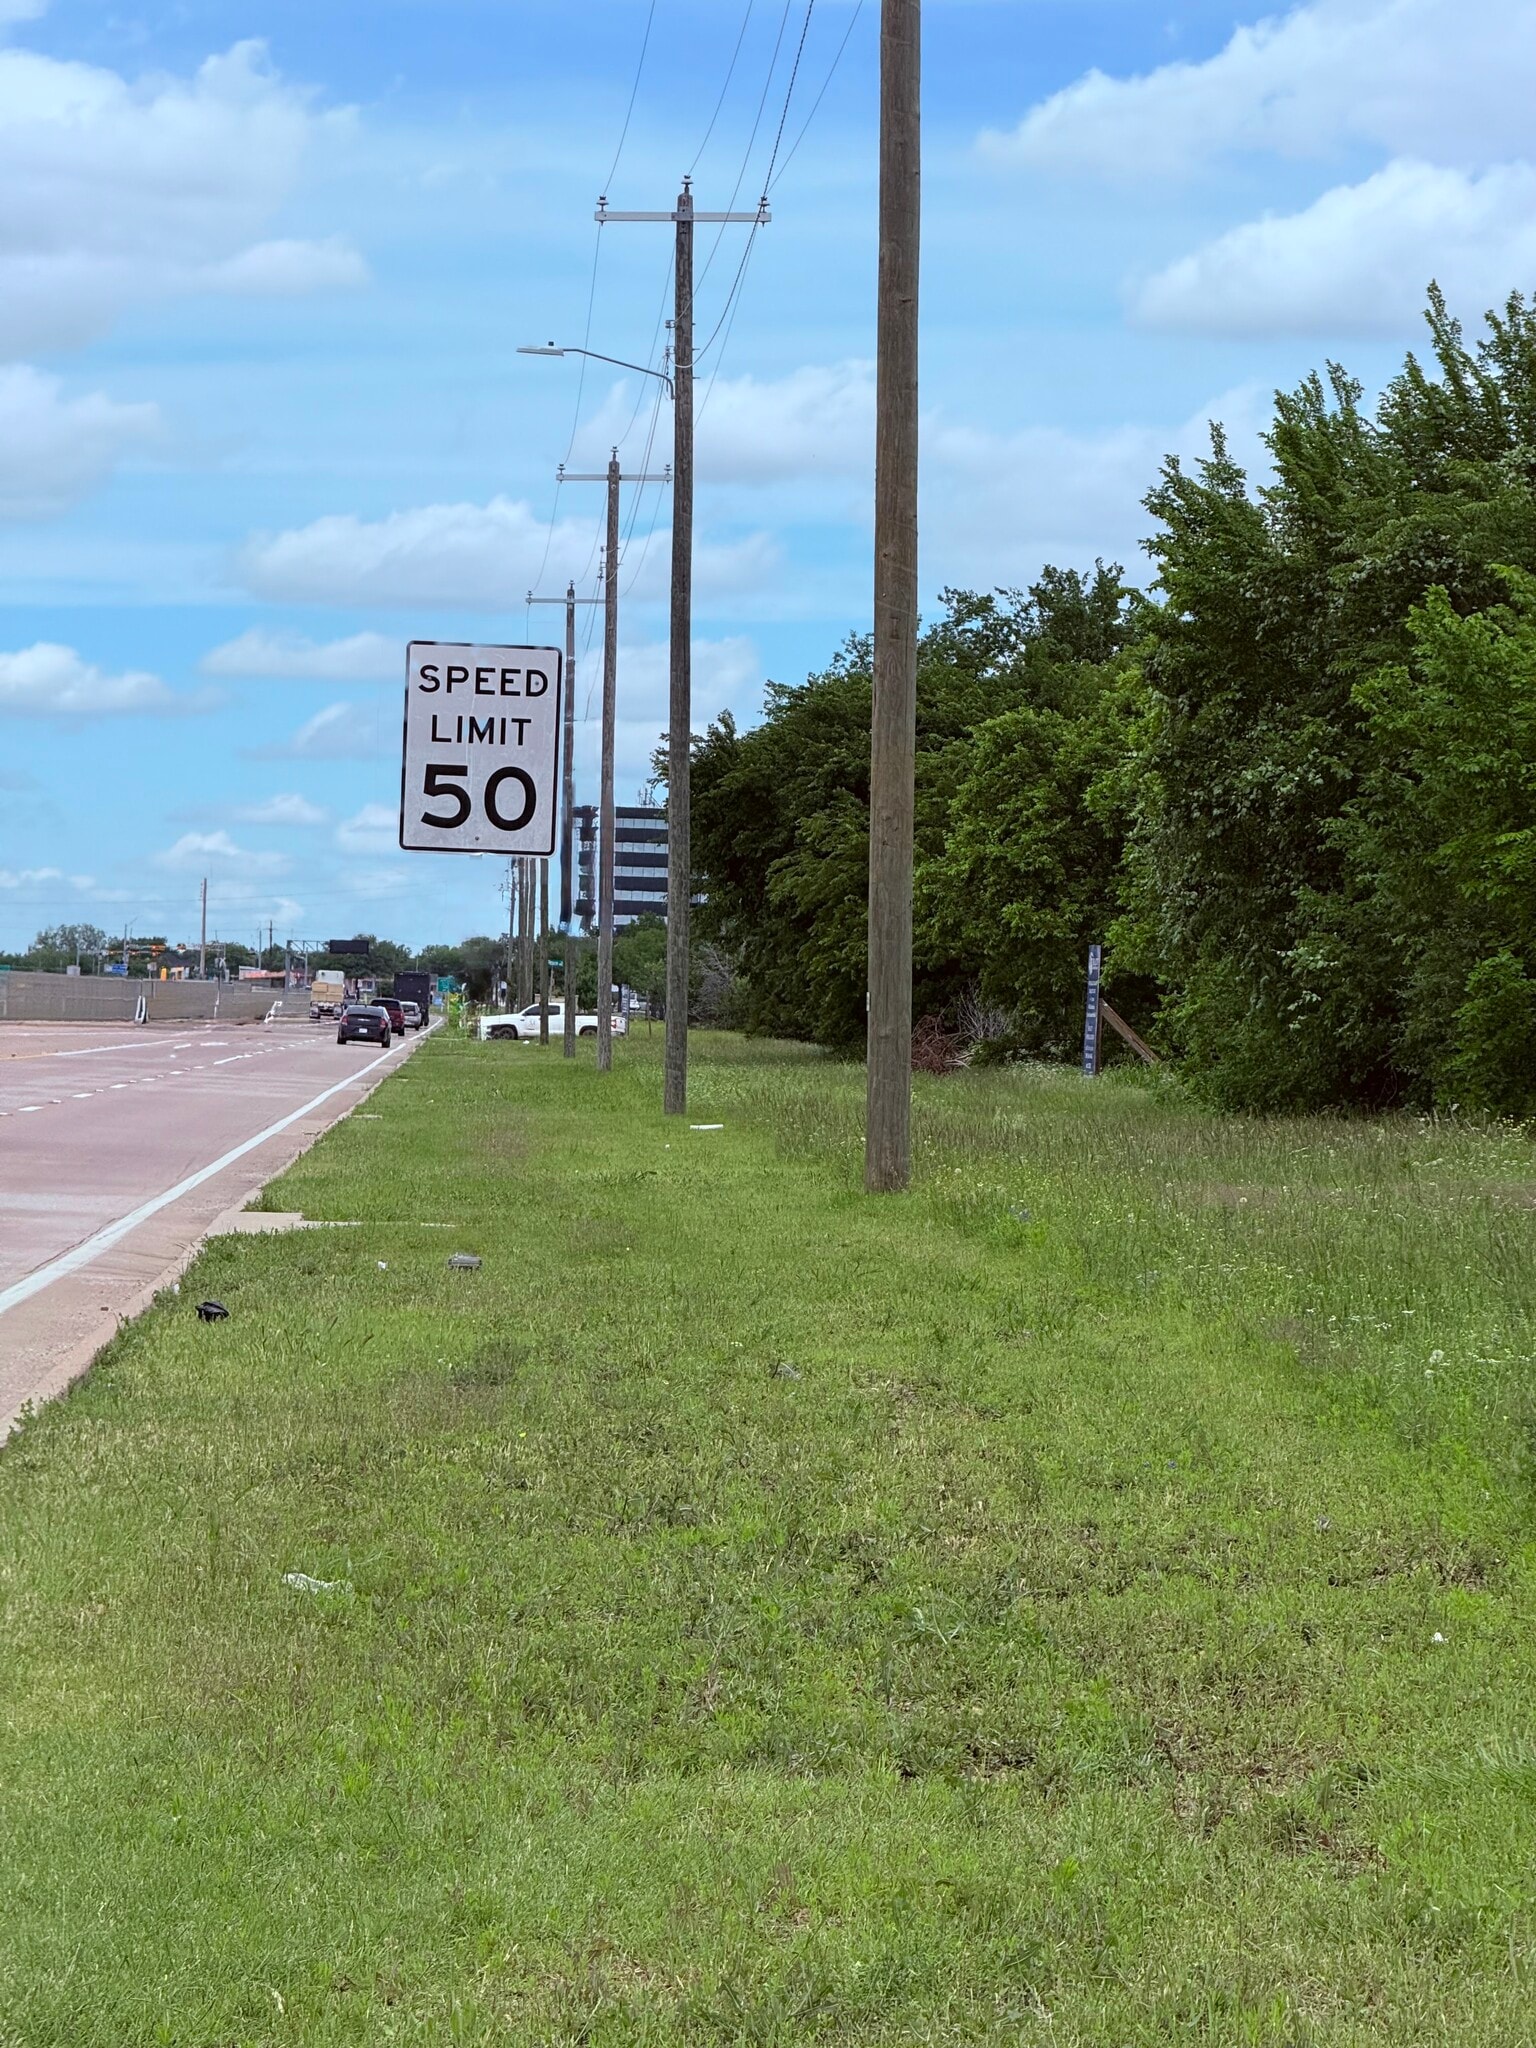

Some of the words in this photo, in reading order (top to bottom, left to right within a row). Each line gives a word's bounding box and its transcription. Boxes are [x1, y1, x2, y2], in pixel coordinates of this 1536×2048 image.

[418, 664, 548, 697] SPEED
[431, 714, 532, 746] LIMIT
[421, 764, 537, 832] 50
